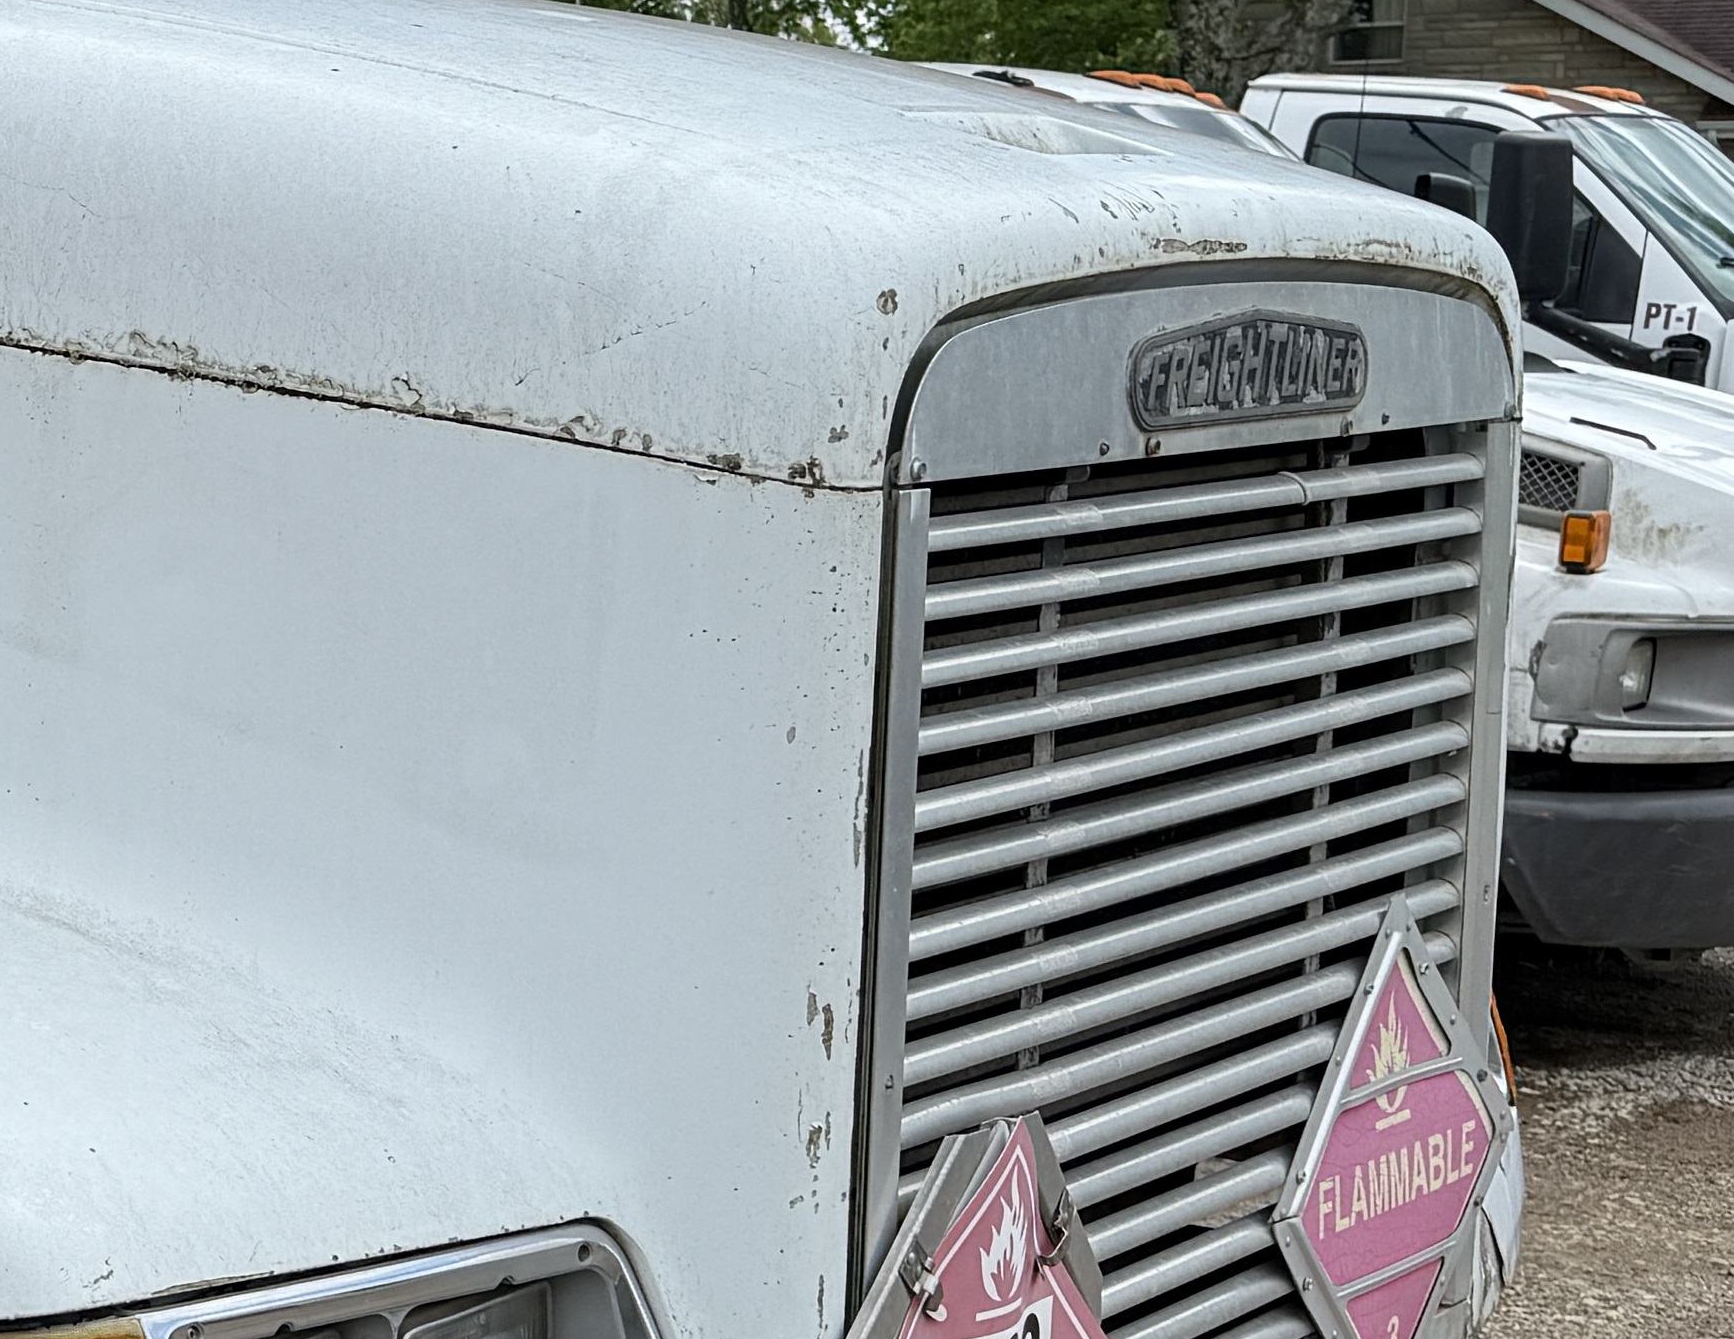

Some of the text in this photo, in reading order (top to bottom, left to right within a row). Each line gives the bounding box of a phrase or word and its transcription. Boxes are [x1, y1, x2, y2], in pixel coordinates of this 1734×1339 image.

[1643, 302, 1698, 332] PT-1
[1149, 320, 1363, 412] FREIGHTLINER
[1317, 1119, 1477, 1240] FLAMMABLE
